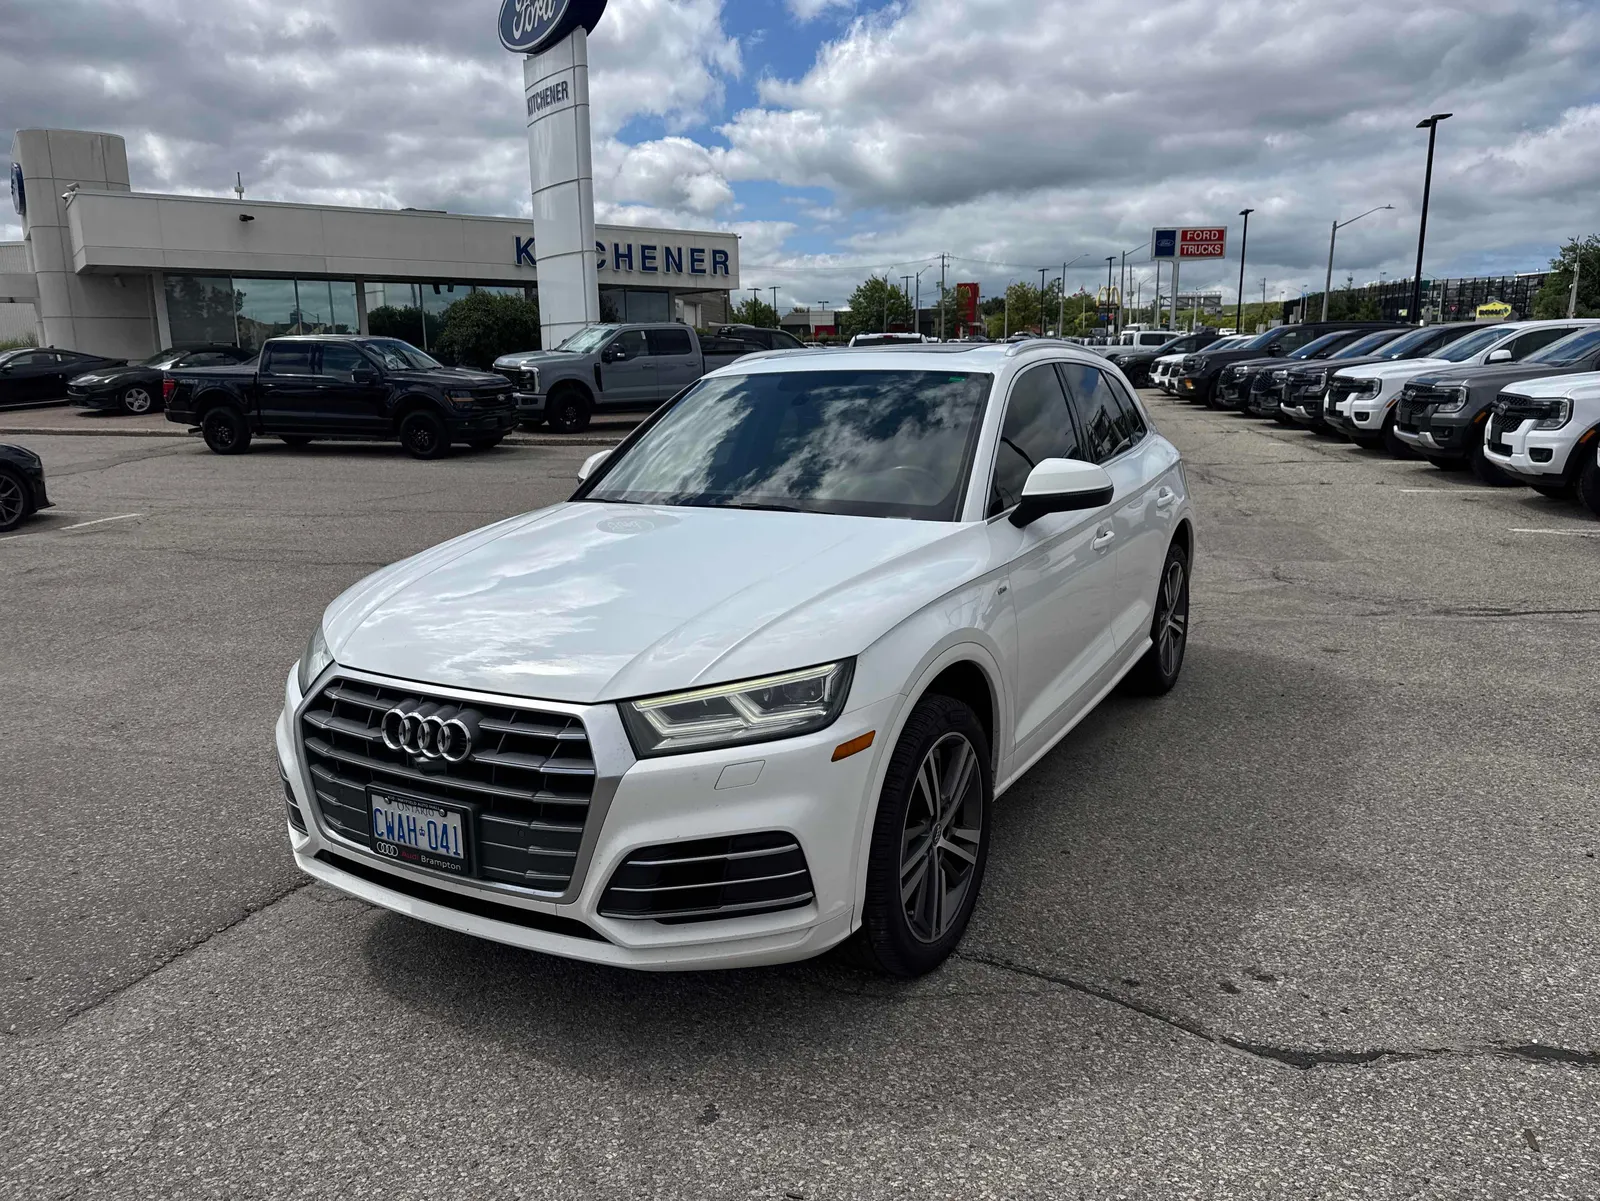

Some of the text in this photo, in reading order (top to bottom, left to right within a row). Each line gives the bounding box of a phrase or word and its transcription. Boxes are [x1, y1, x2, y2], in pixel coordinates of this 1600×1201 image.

[527, 81, 569, 117] KITCHENER
[1187, 231, 1219, 240] FORD
[1182, 245, 1221, 255] TRUCKS
[397, 801, 434, 817] ONTARIO
[373, 807, 461, 857] CWAH 041
[401, 850, 461, 871] Audi Brampton
